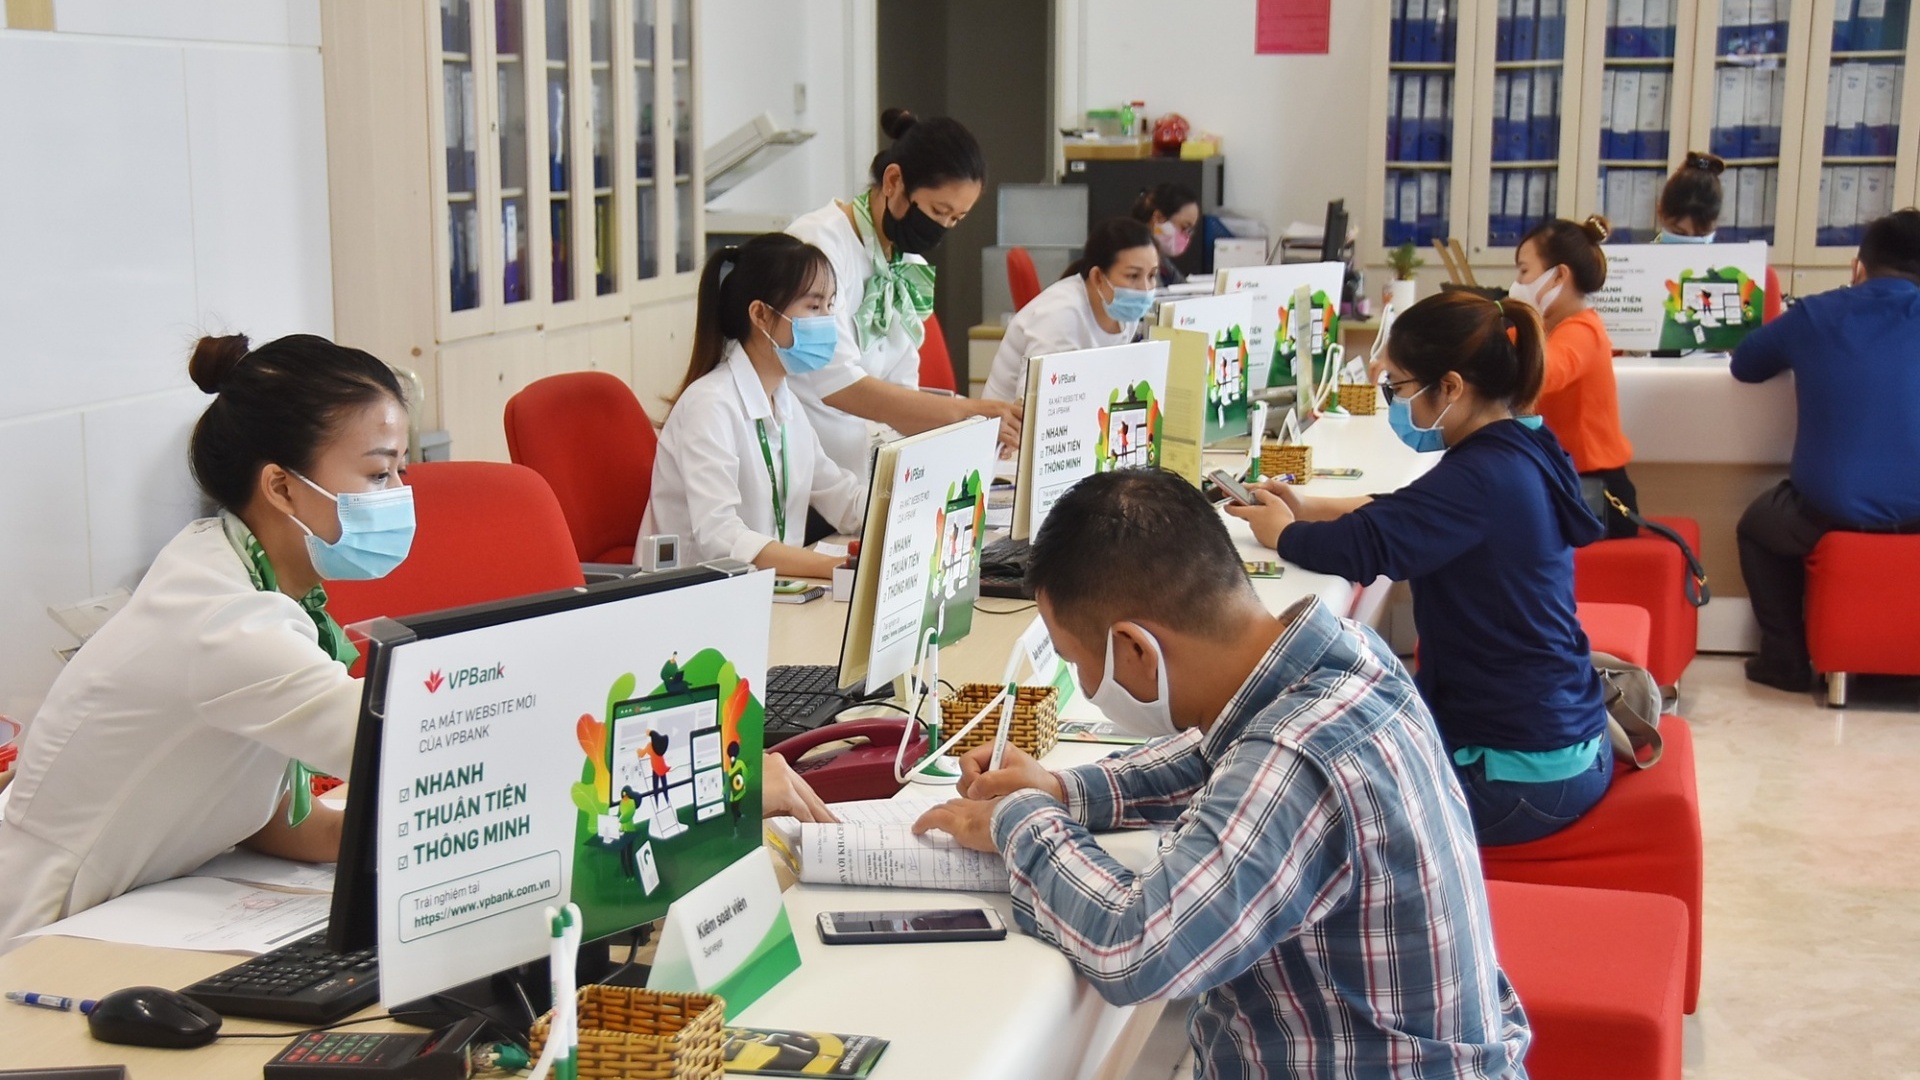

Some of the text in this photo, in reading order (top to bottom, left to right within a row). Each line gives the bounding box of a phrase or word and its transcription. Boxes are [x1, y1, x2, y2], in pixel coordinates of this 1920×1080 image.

[1045, 424, 1068, 440] NHANH
[448, 661, 506, 690] VPBank
[420, 719, 436, 733] RA
[465, 699, 514, 723] WEBSITE
[445, 724, 490, 748] VPBANK
[414, 761, 484, 799] NHANH
[414, 782, 527, 832] THUẬN TIỆN
[413, 814, 531, 866] THÔNG MINH
[414, 878, 551, 929] https://www.vpbank.com.vn
[434, 886, 467, 906] nghiệm
[468, 880, 480, 895] tại
